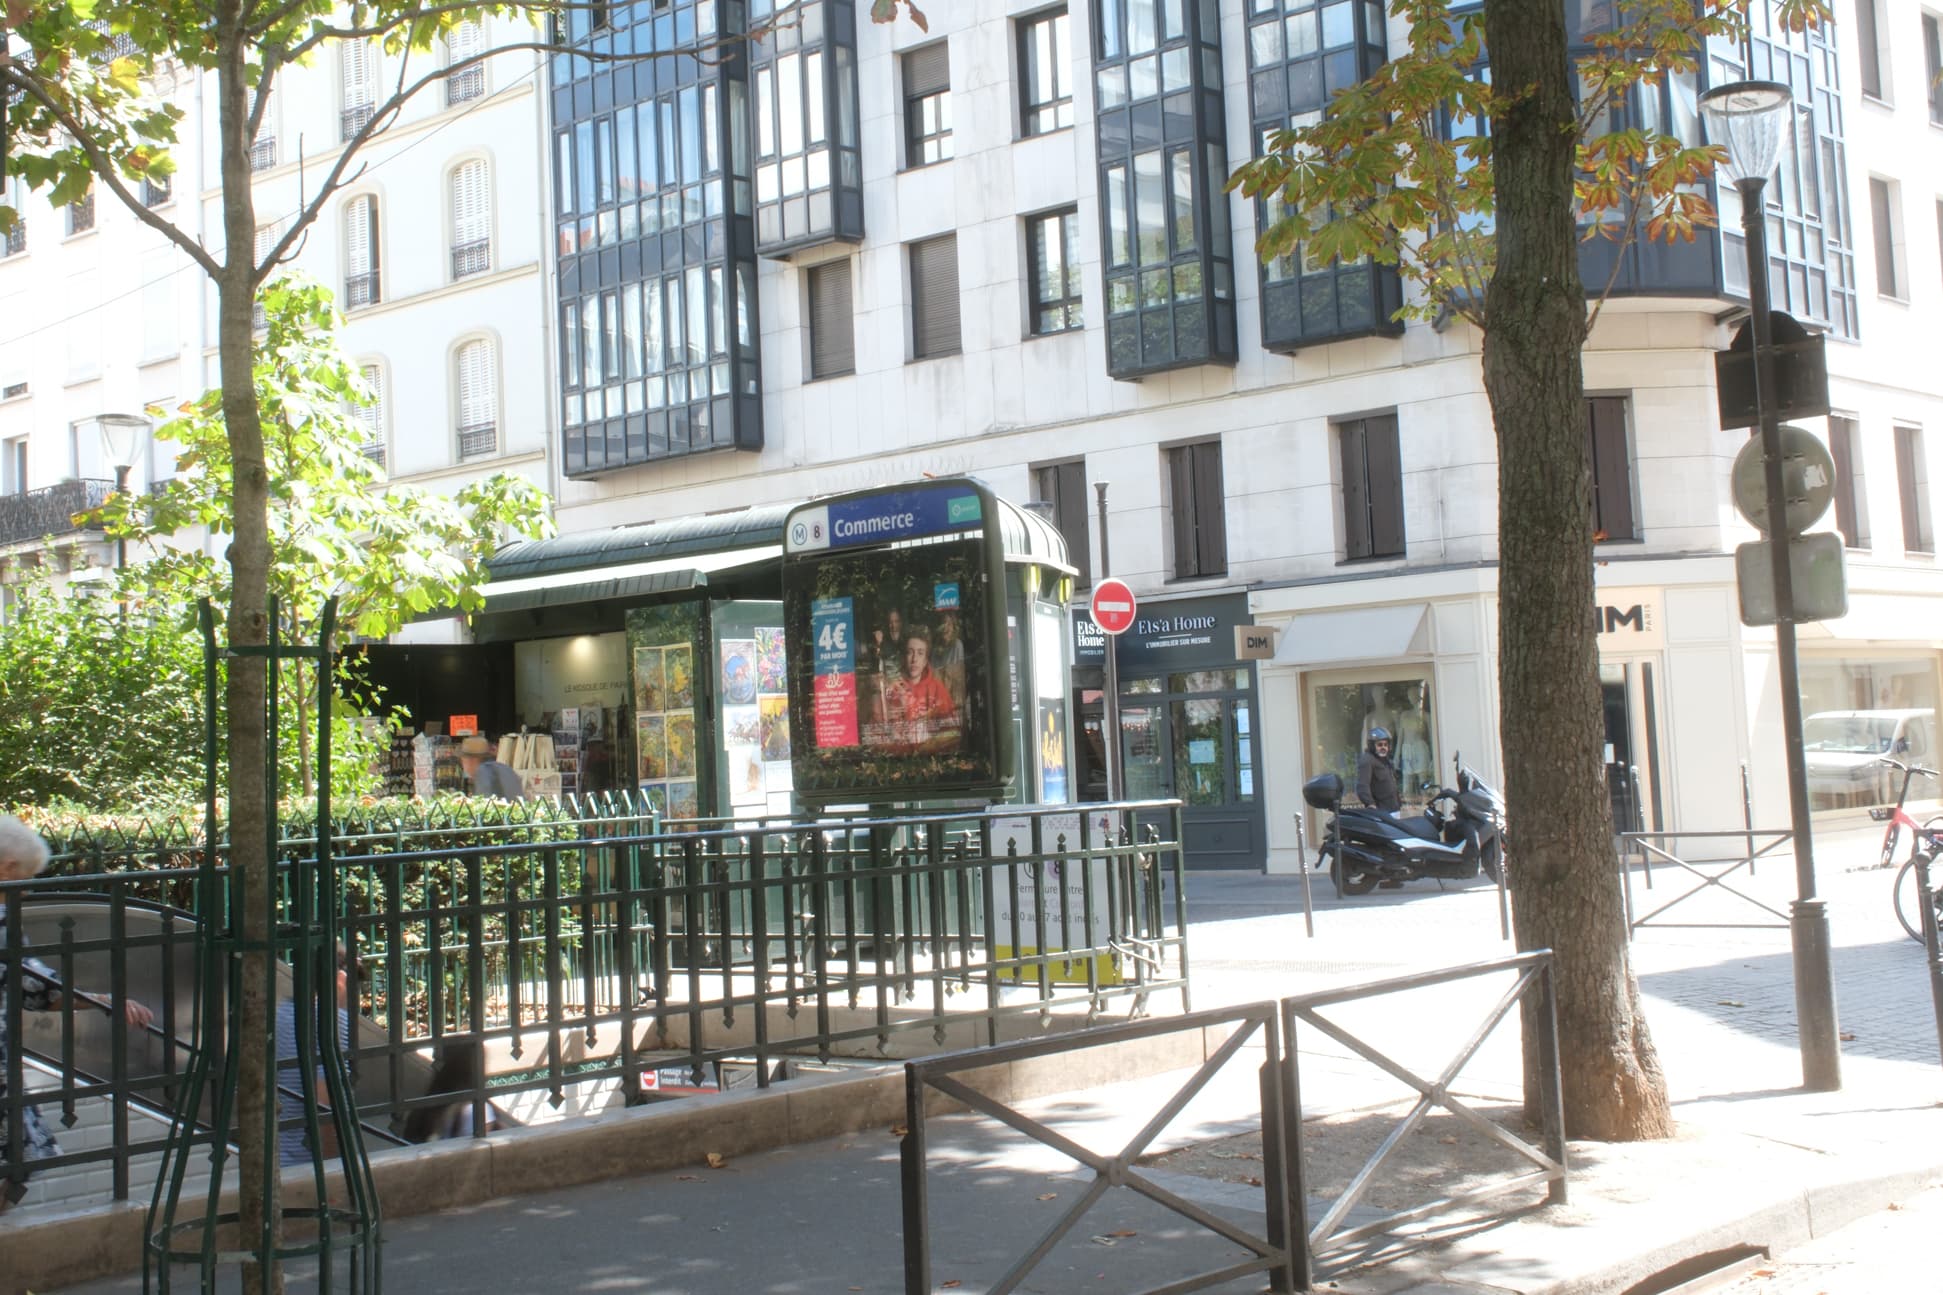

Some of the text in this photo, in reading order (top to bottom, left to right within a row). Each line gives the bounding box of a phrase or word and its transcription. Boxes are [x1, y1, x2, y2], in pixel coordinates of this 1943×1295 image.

[813, 524, 821, 539] 8
[834, 512, 914, 538] Commerce
[1138, 616, 1216, 635] Els'a Home
[1595, 604, 1644, 633] IM
[818, 622, 847, 651] 4€
[1078, 635, 1105, 647] Home
[1180, 638, 1190, 646] SUR
[1190, 636, 1211, 645] MESURE
[1247, 636, 1268, 649] DIM
